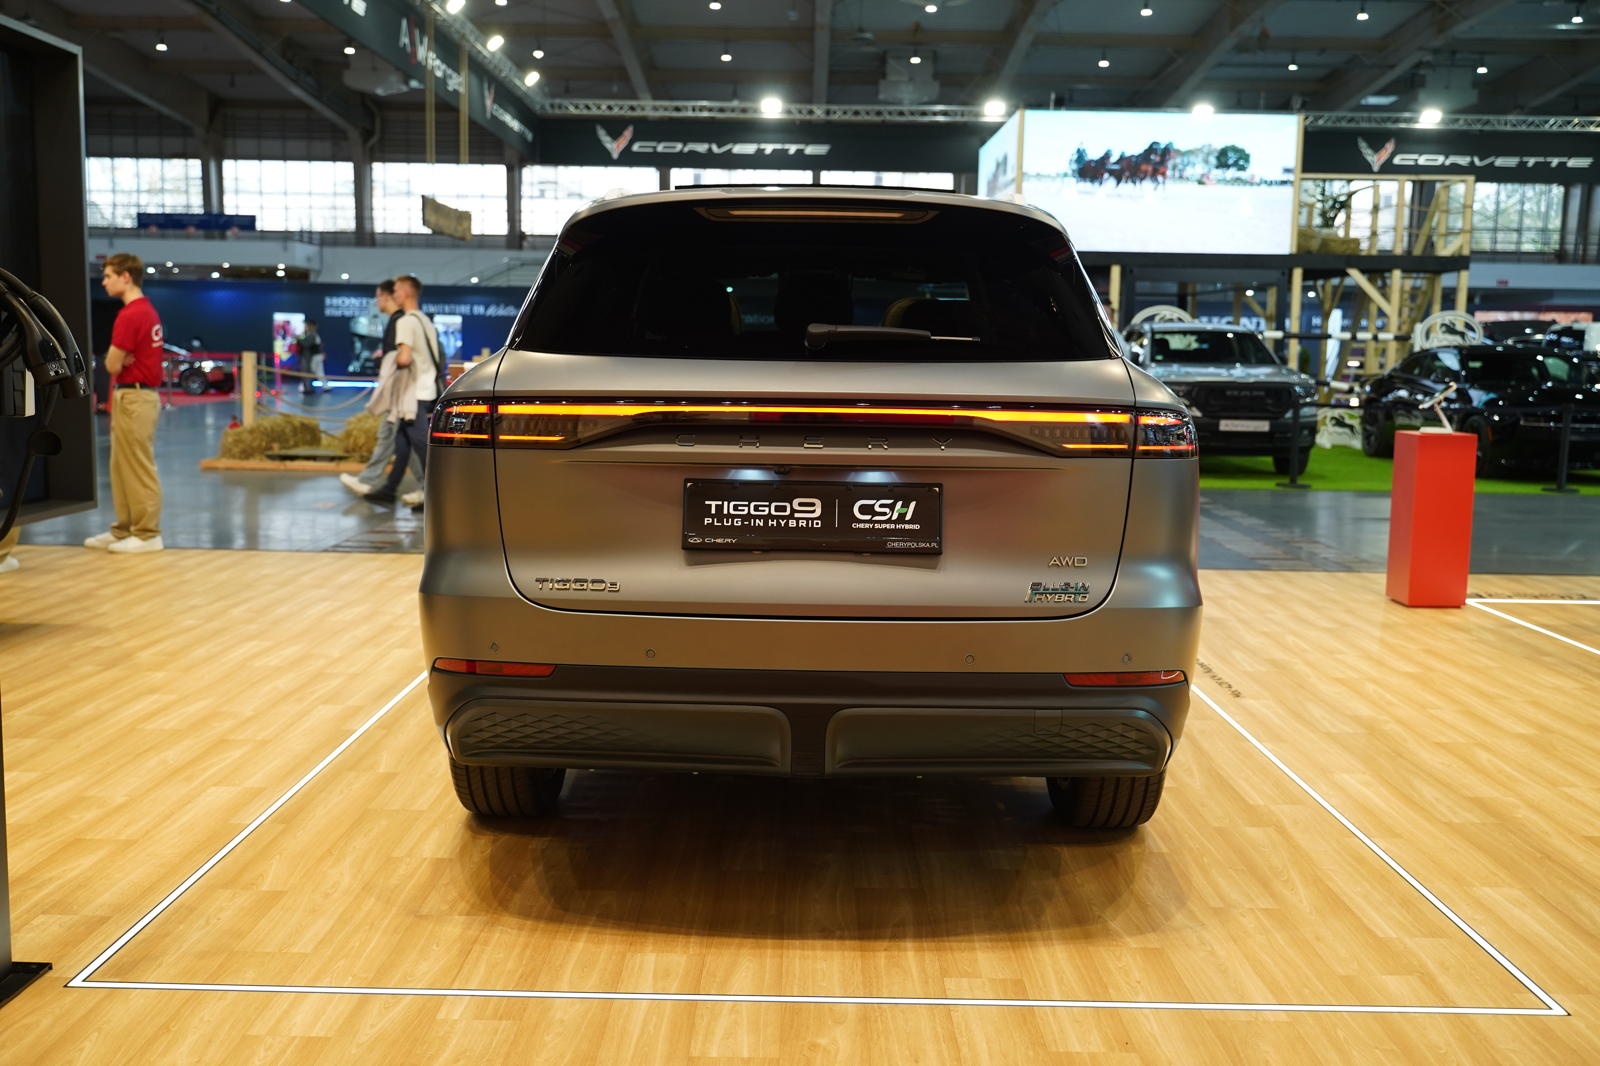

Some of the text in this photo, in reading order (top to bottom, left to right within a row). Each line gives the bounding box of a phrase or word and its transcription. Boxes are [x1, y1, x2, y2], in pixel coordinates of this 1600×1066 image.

[631, 141, 831, 155] CORVETTE
[1392, 153, 1594, 168] CORVETTE
[675, 434, 953, 450] CHERY
[853, 499, 917, 521] CSH
[704, 517, 822, 528] PLUG-IN HYBRID
[886, 541, 939, 549] CHERYPOLSKA.PL
[1048, 556, 1088, 568] AWD
[1030, 582, 1089, 592] PLUG-IN
[1035, 593, 1089, 603] HYBRID
